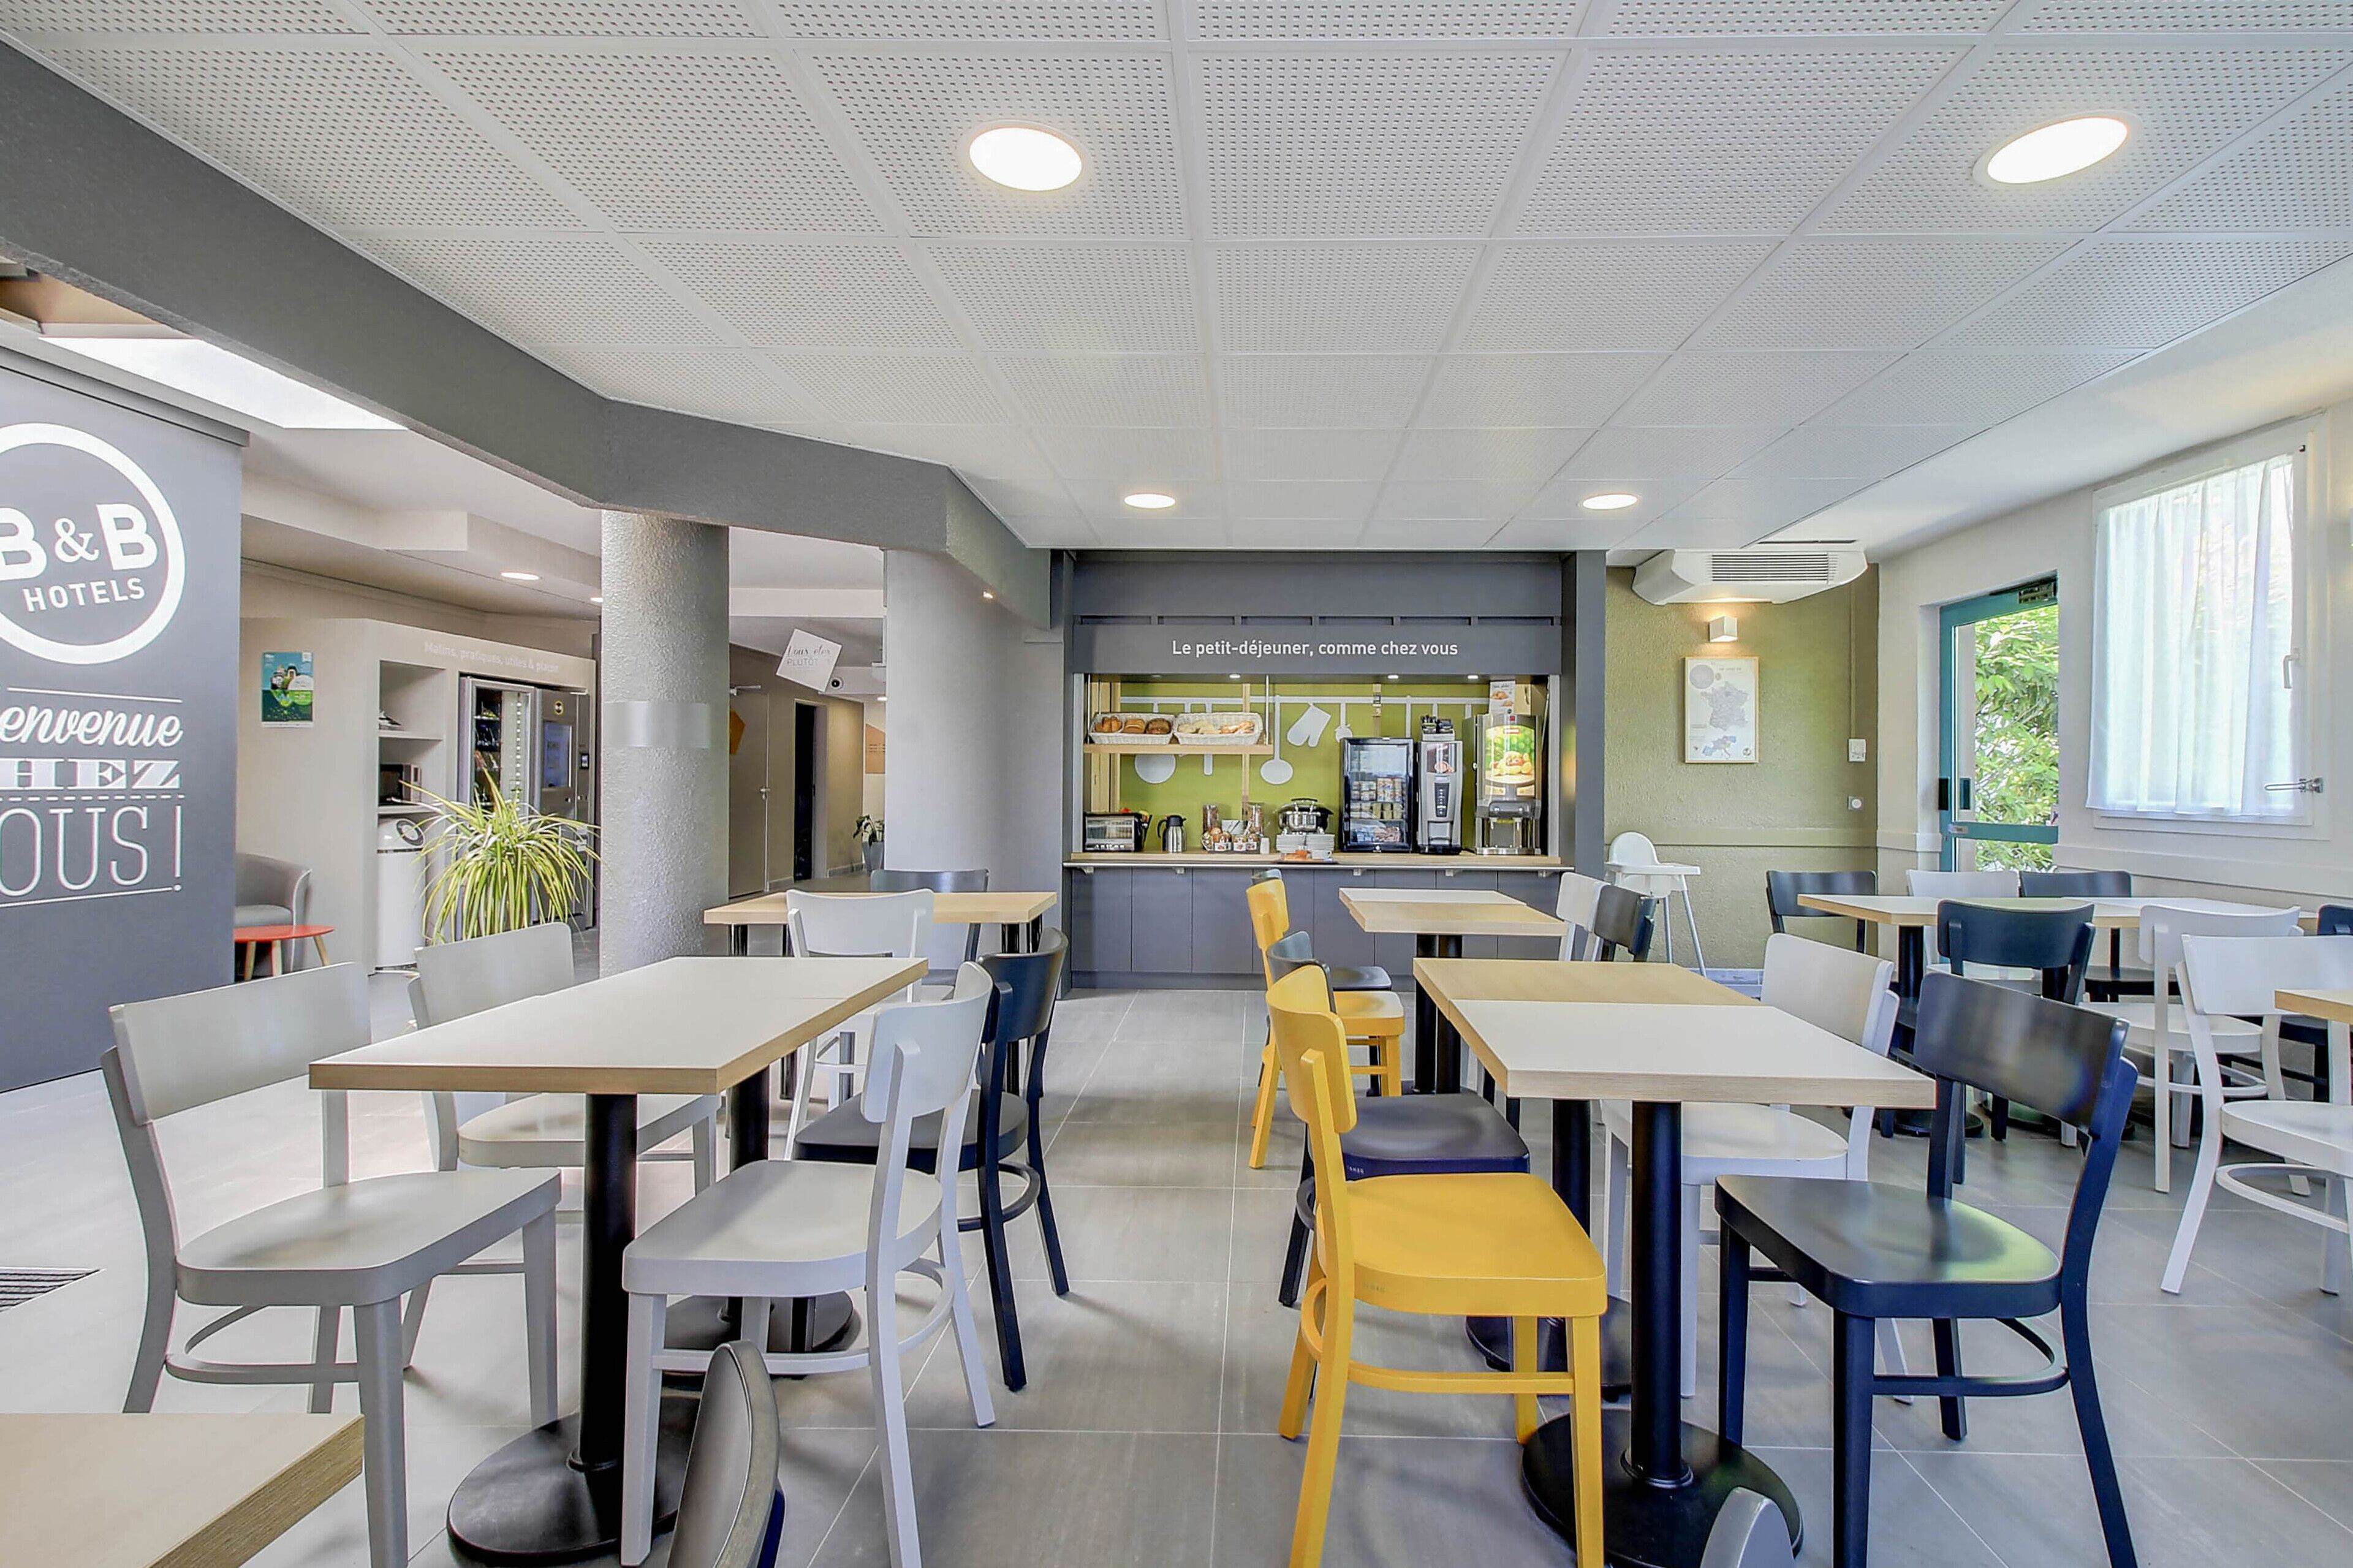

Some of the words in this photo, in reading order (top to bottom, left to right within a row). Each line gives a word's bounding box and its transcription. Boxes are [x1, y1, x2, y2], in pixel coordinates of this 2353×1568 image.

[0, 503, 157, 580] B&B
[23, 578, 145, 612] HOTELS
[1172, 640, 1191, 654] Le
[1196, 640, 1314, 657] petit-déjeuner,
[1318, 643, 1376, 655] comme
[1381, 641, 1417, 655] chez
[1421, 643, 1458, 655] vous
